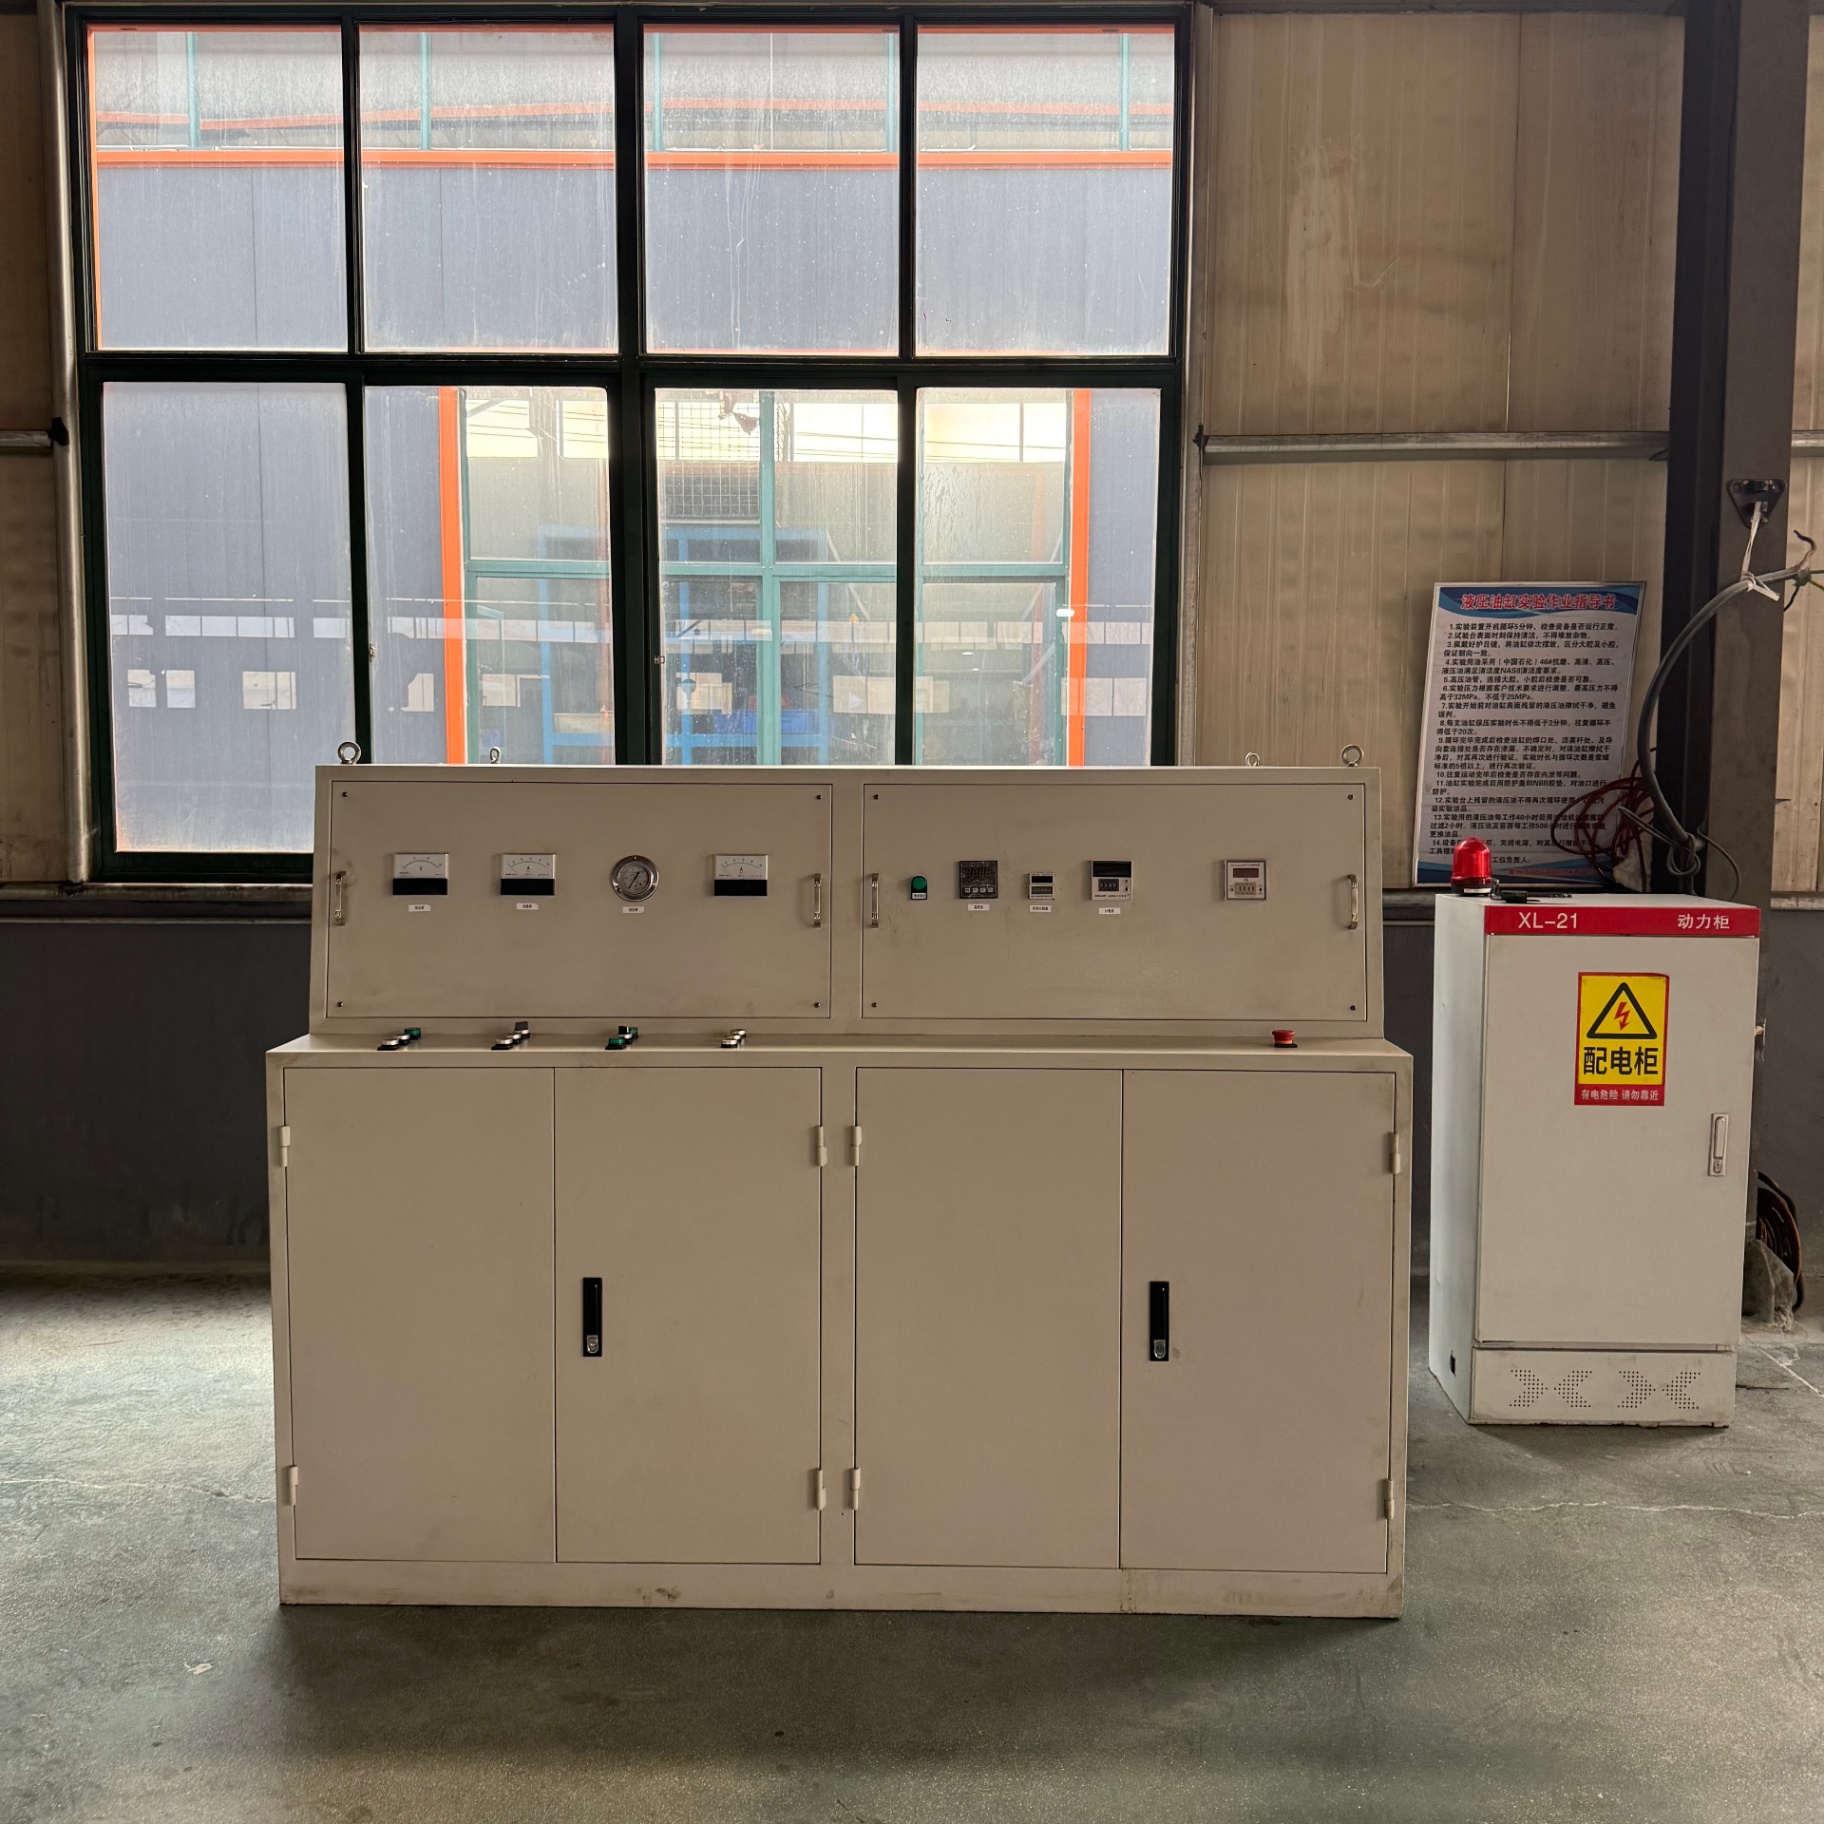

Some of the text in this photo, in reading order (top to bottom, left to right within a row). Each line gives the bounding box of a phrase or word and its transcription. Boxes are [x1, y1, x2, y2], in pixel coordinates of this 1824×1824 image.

[1518, 912, 1579, 929] XL-21
[1677, 914, 1730, 930] 动力柜
[1583, 1046, 1659, 1076] 配电柜
[1581, 1089, 1659, 1101] 有电危险 请勿靠近
